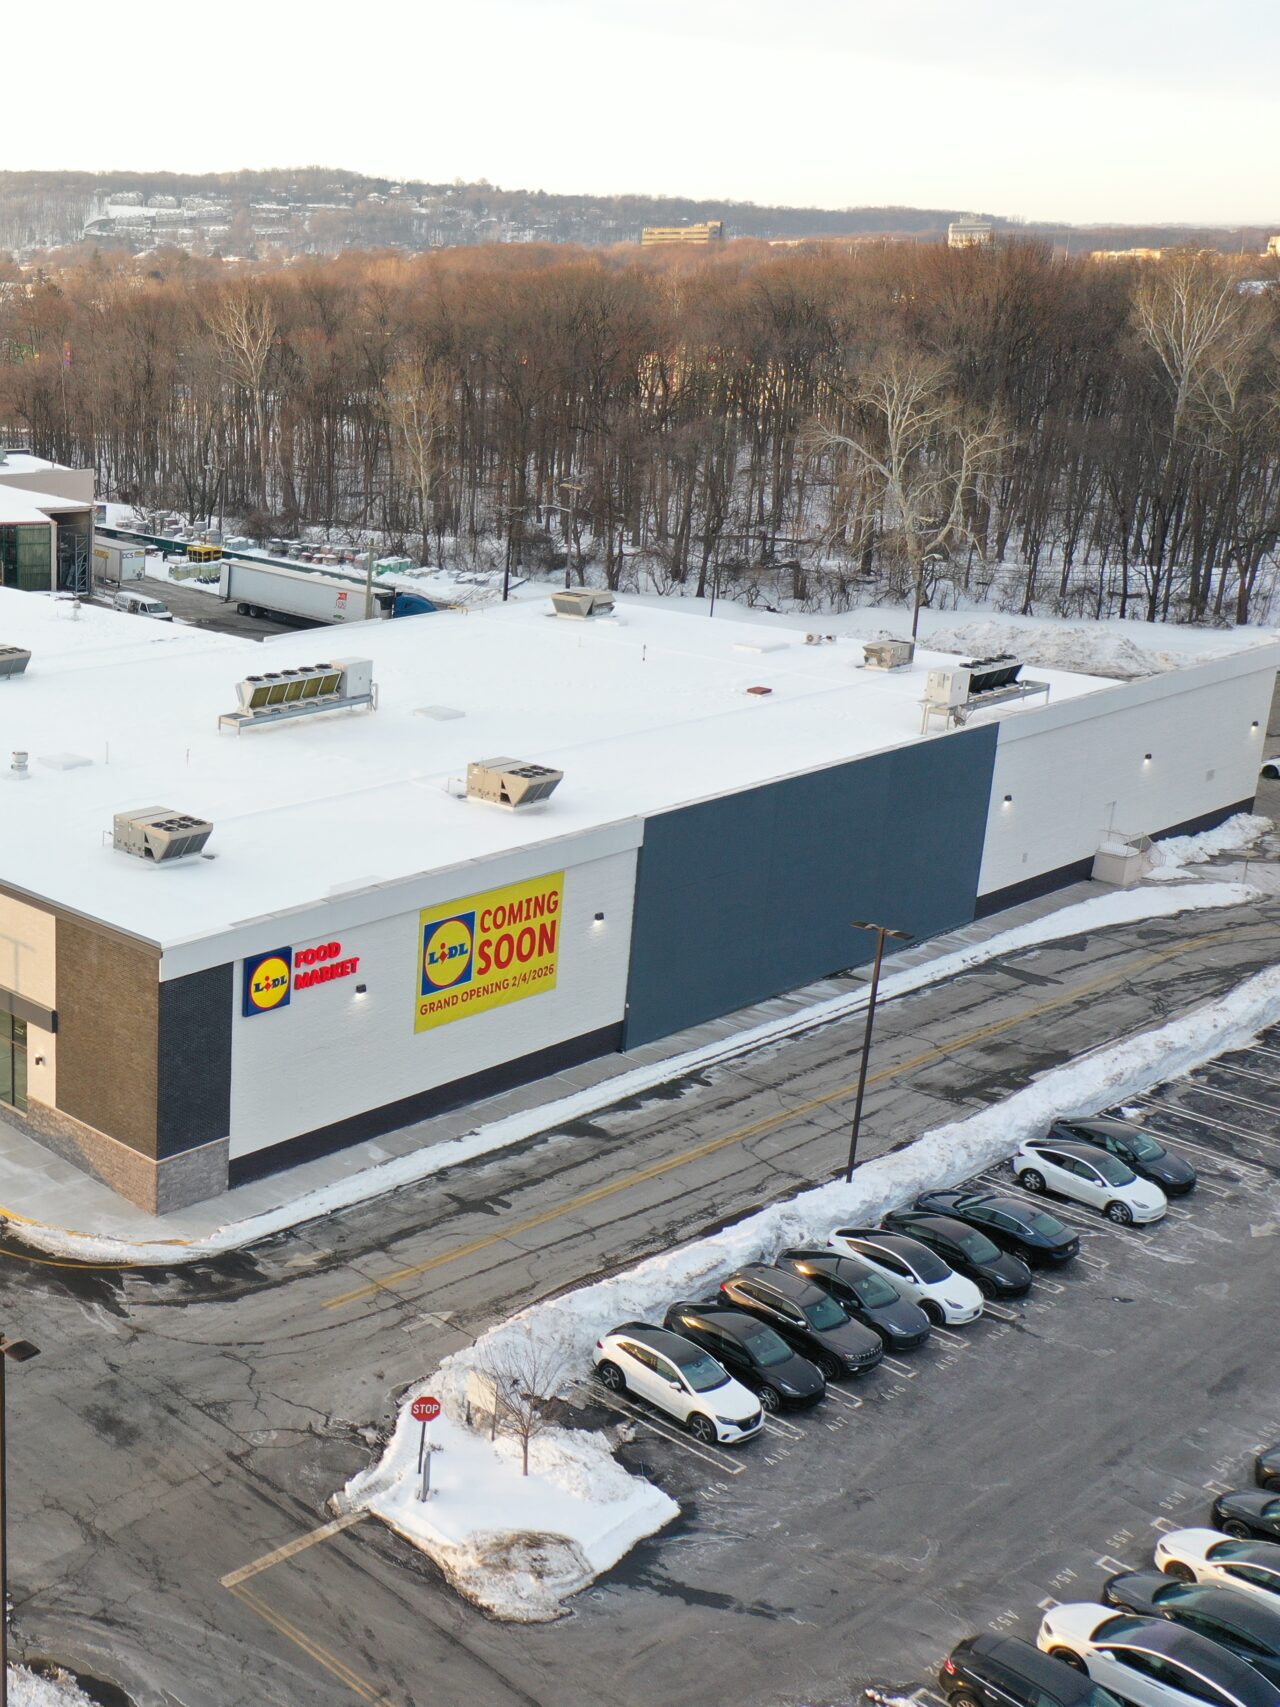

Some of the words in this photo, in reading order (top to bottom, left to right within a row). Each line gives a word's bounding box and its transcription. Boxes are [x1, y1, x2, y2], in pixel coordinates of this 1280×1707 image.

[480, 890, 559, 934] COMING
[295, 941, 342, 969] FOOD
[477, 919, 558, 976] SOON
[295, 956, 360, 991] MARKET
[420, 995, 459, 1016] GRAND
[461, 978, 510, 1006] OPENING
[511, 963, 555, 990] 2/4/2026
[880, 1385, 906, 1400] A16
[413, 1404, 439, 1414] STOP
[825, 1416, 848, 1432] A17
[1106, 1528, 1134, 1548] A55
[1048, 1568, 1078, 1589] A54
[988, 1609, 1020, 1630] A53
